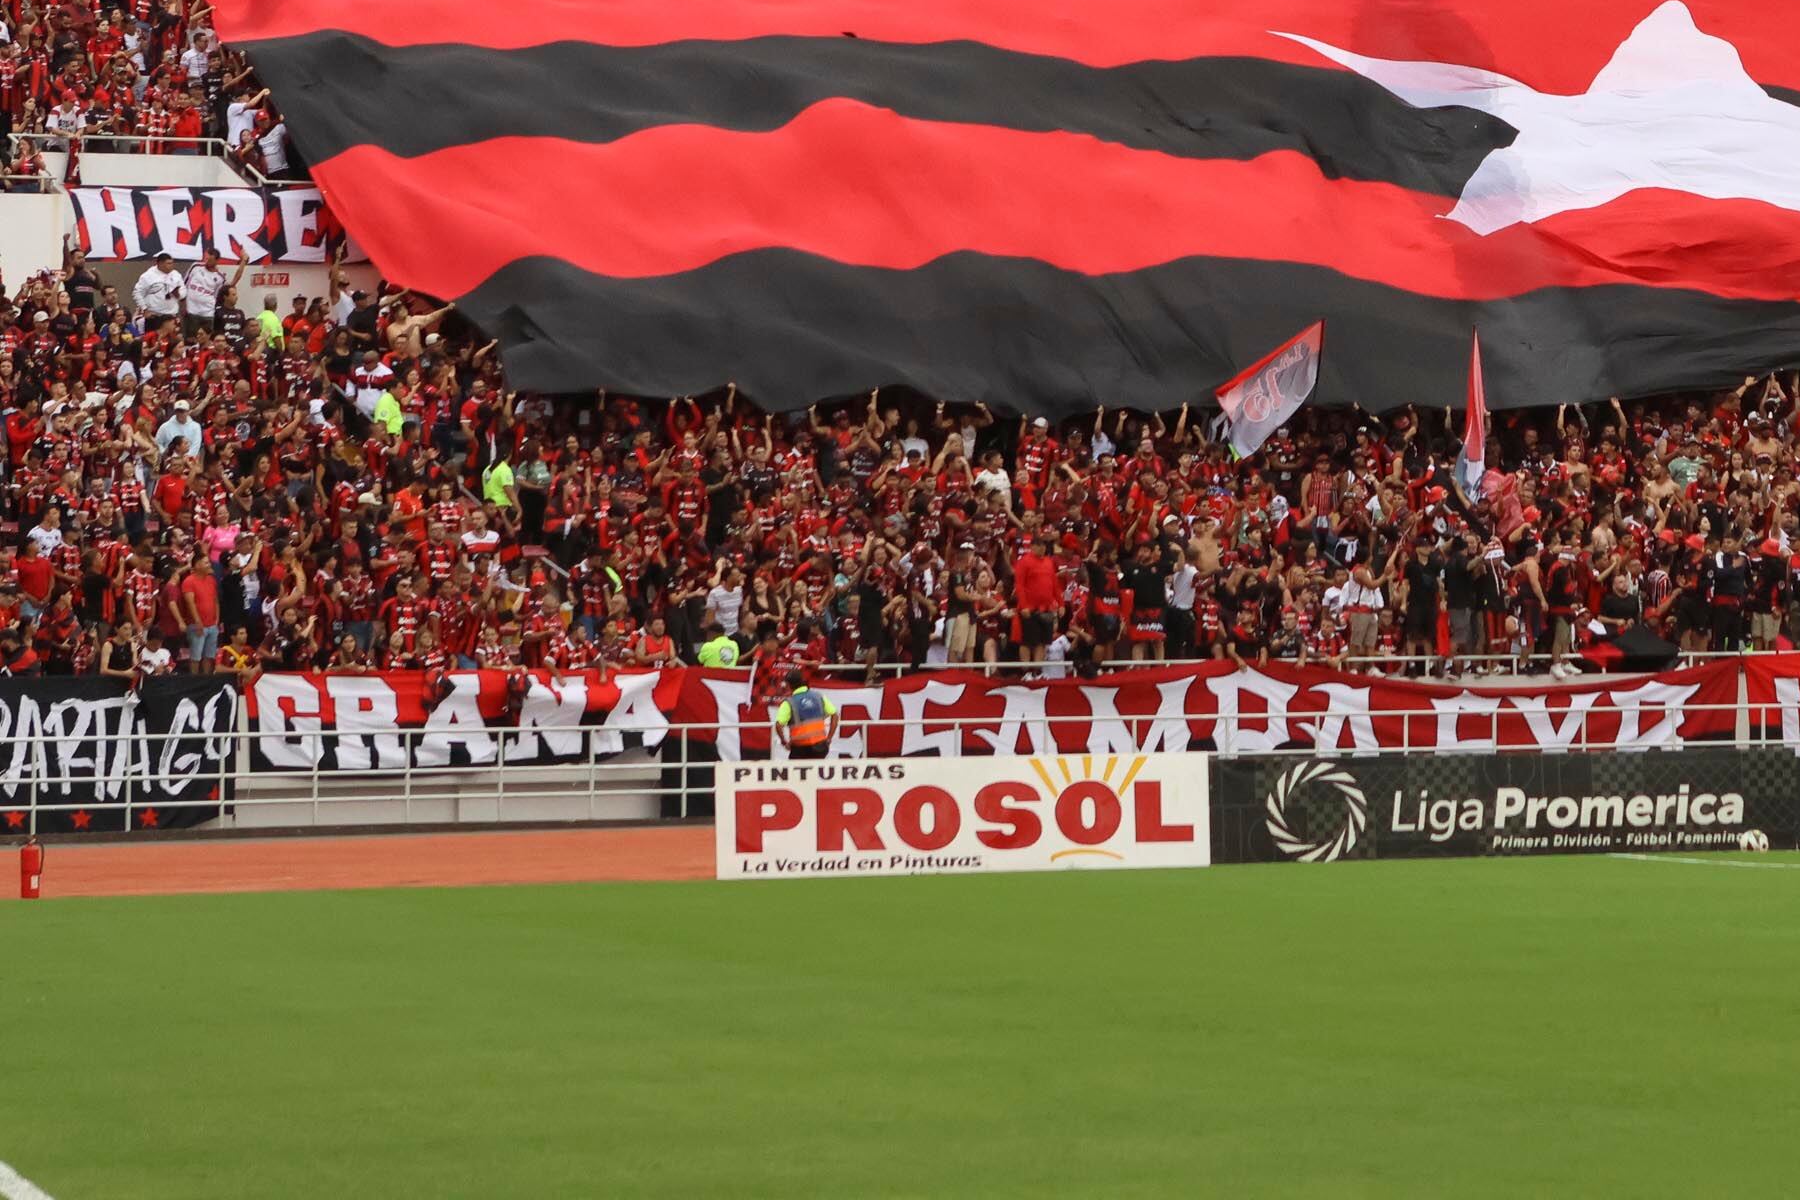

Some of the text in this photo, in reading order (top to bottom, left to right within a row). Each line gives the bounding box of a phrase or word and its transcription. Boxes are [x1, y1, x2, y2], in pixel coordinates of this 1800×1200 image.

[66, 188, 368, 263] HERE
[254, 670, 670, 770] GRANA
[733, 764, 905, 782] PINTURAS
[735, 780, 1195, 853] PROSOL
[1392, 784, 1744, 842] Liga Promerica
[1493, 834, 1549, 849] Primera
[1553, 831, 1611, 848] División
[1626, 830, 1672, 846] Fútbol
[742, 853, 982, 873] La Verdad en Pinturas
